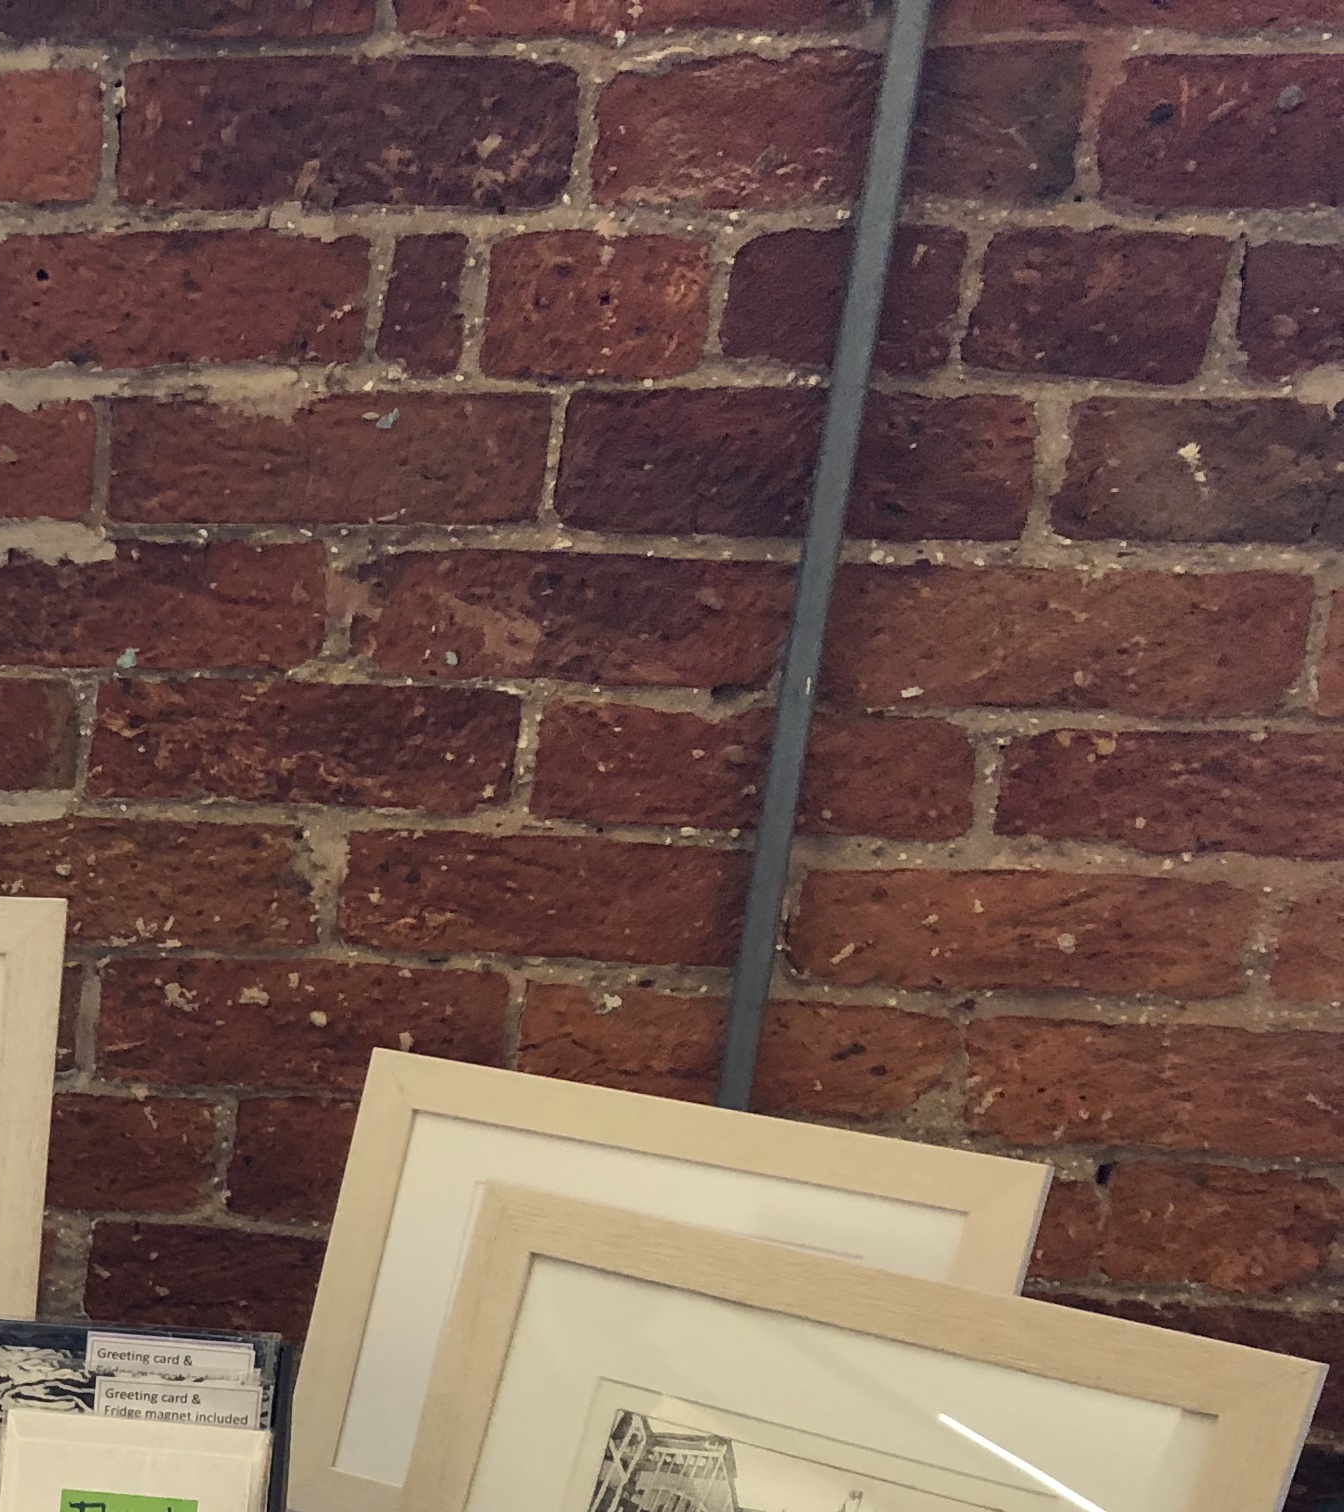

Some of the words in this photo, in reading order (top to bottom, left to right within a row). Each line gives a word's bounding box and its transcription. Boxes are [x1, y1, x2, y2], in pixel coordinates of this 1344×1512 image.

[97, 1347, 150, 1365] Greeting
[153, 1351, 180, 1365] card
[183, 1355, 193, 1366] &
[105, 1388, 158, 1404] Greeting
[161, 1393, 188, 1404] card
[191, 1394, 201, 1404] &
[104, 1405, 141, 1419] Fridge
[145, 1410, 191, 1422] magnet
[195, 1411, 248, 1426] included
